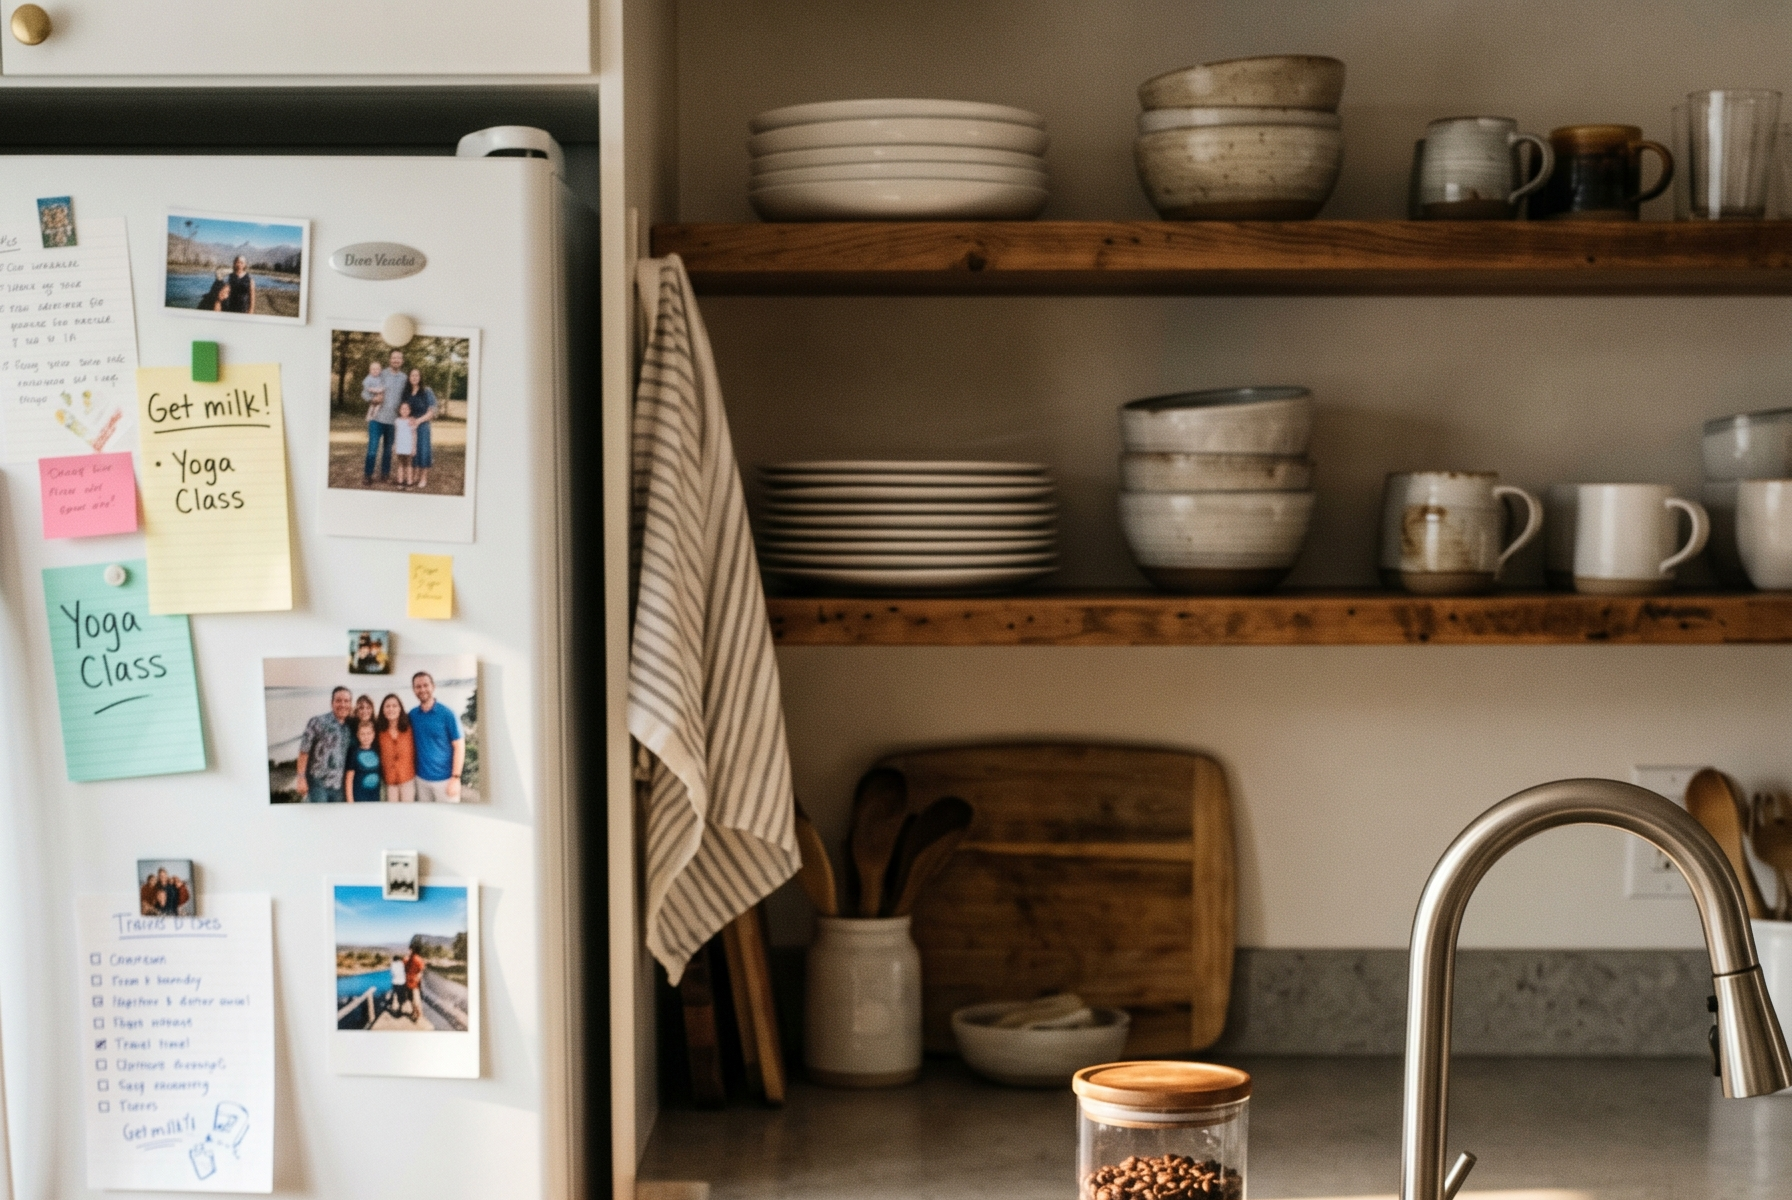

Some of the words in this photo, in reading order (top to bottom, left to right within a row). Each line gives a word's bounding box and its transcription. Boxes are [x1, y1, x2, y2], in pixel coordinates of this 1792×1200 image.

[147, 392, 193, 423] Get
[205, 382, 271, 419] milk!
[171, 449, 235, 486] Yoga
[175, 488, 245, 514] Class
[60, 599, 142, 653] Yoga
[80, 653, 167, 689] Class
